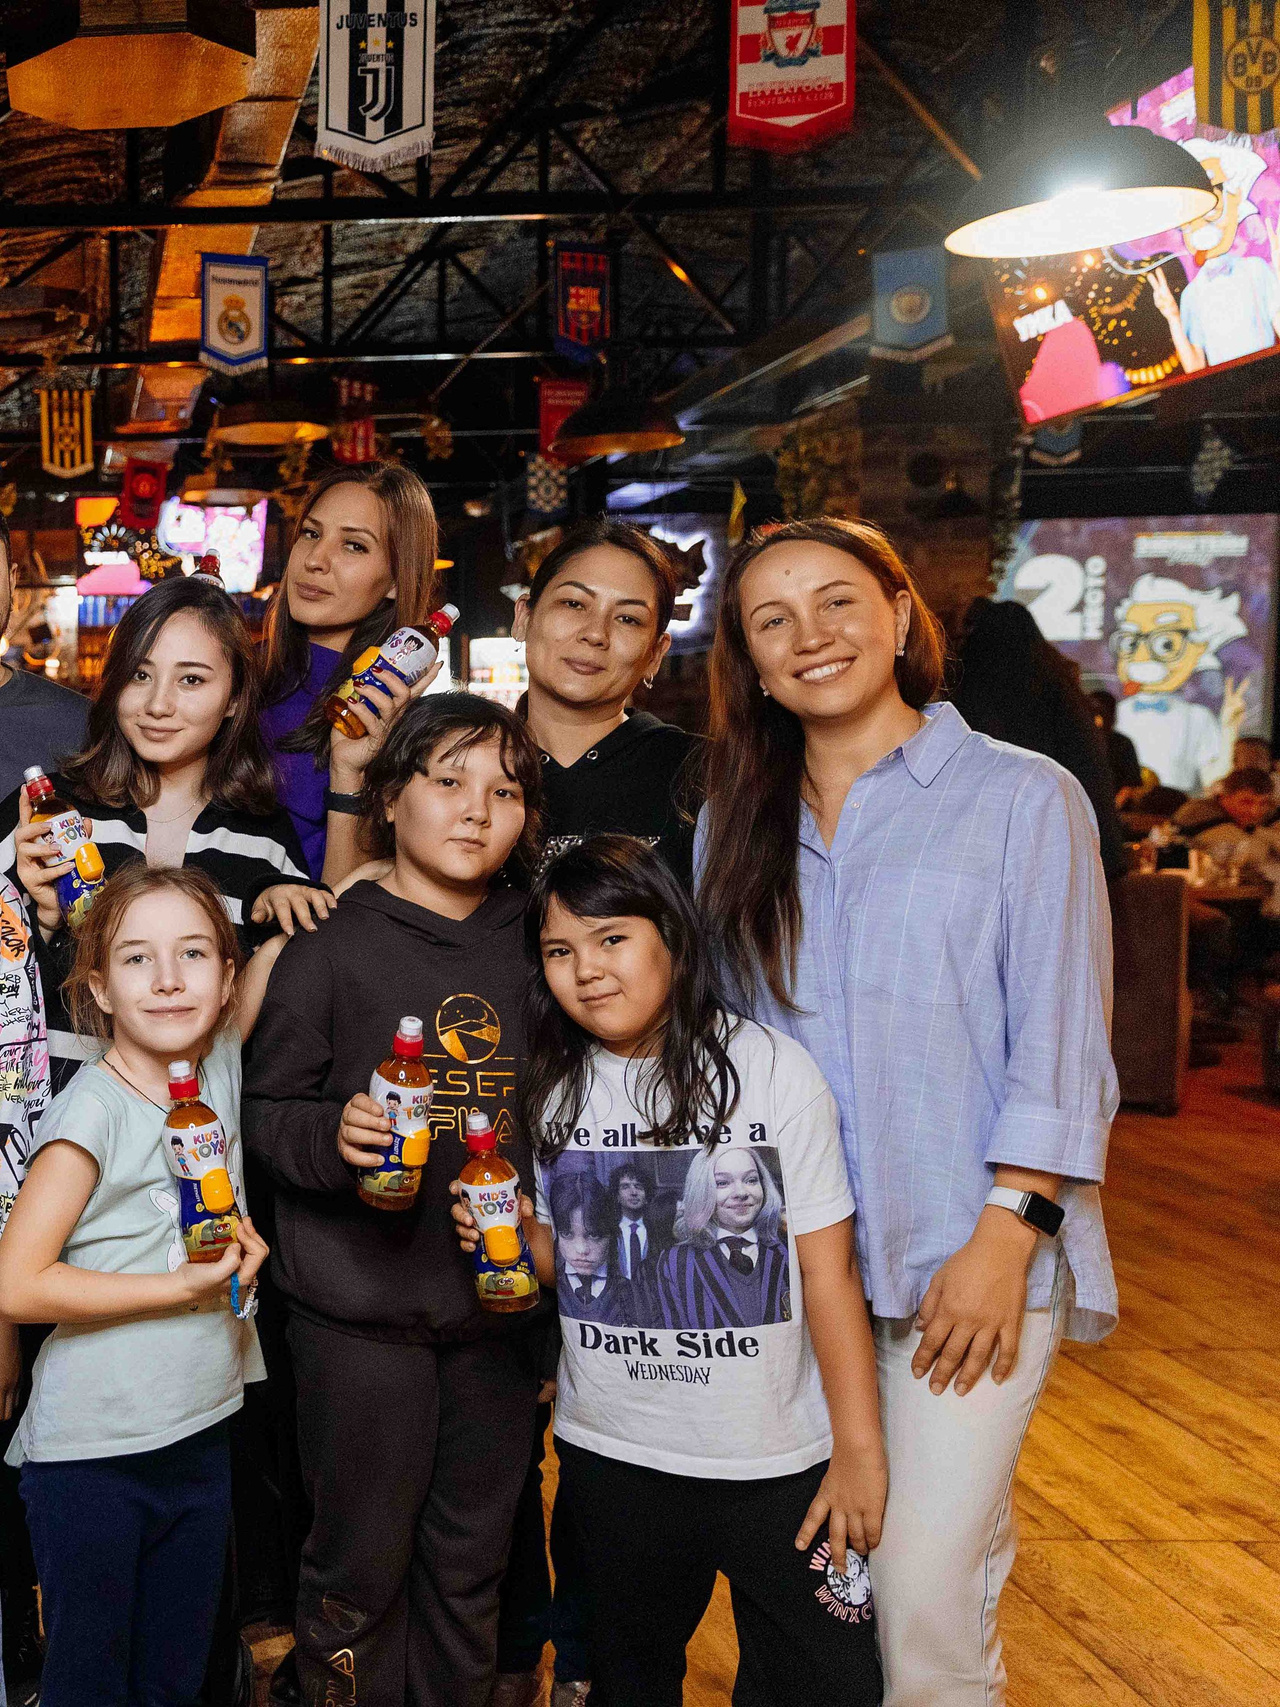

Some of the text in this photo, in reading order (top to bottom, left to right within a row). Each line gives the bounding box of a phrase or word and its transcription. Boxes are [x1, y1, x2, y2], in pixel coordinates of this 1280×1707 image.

[336, 12, 418, 30] JUVENTUS
[59, 814, 81, 830] KID'S
[57, 823, 87, 845] TOYS
[193, 1129, 219, 1145] KID'S
[602, 1122, 637, 1148] all
[748, 1122, 767, 1143] a
[187, 1139, 226, 1163] TOYS
[478, 1189, 509, 1202] KID'S
[474, 1198, 516, 1217] TOYS
[579, 1322, 760, 1359] Dark Side
[623, 1359, 712, 1386] WEDNESDAY
